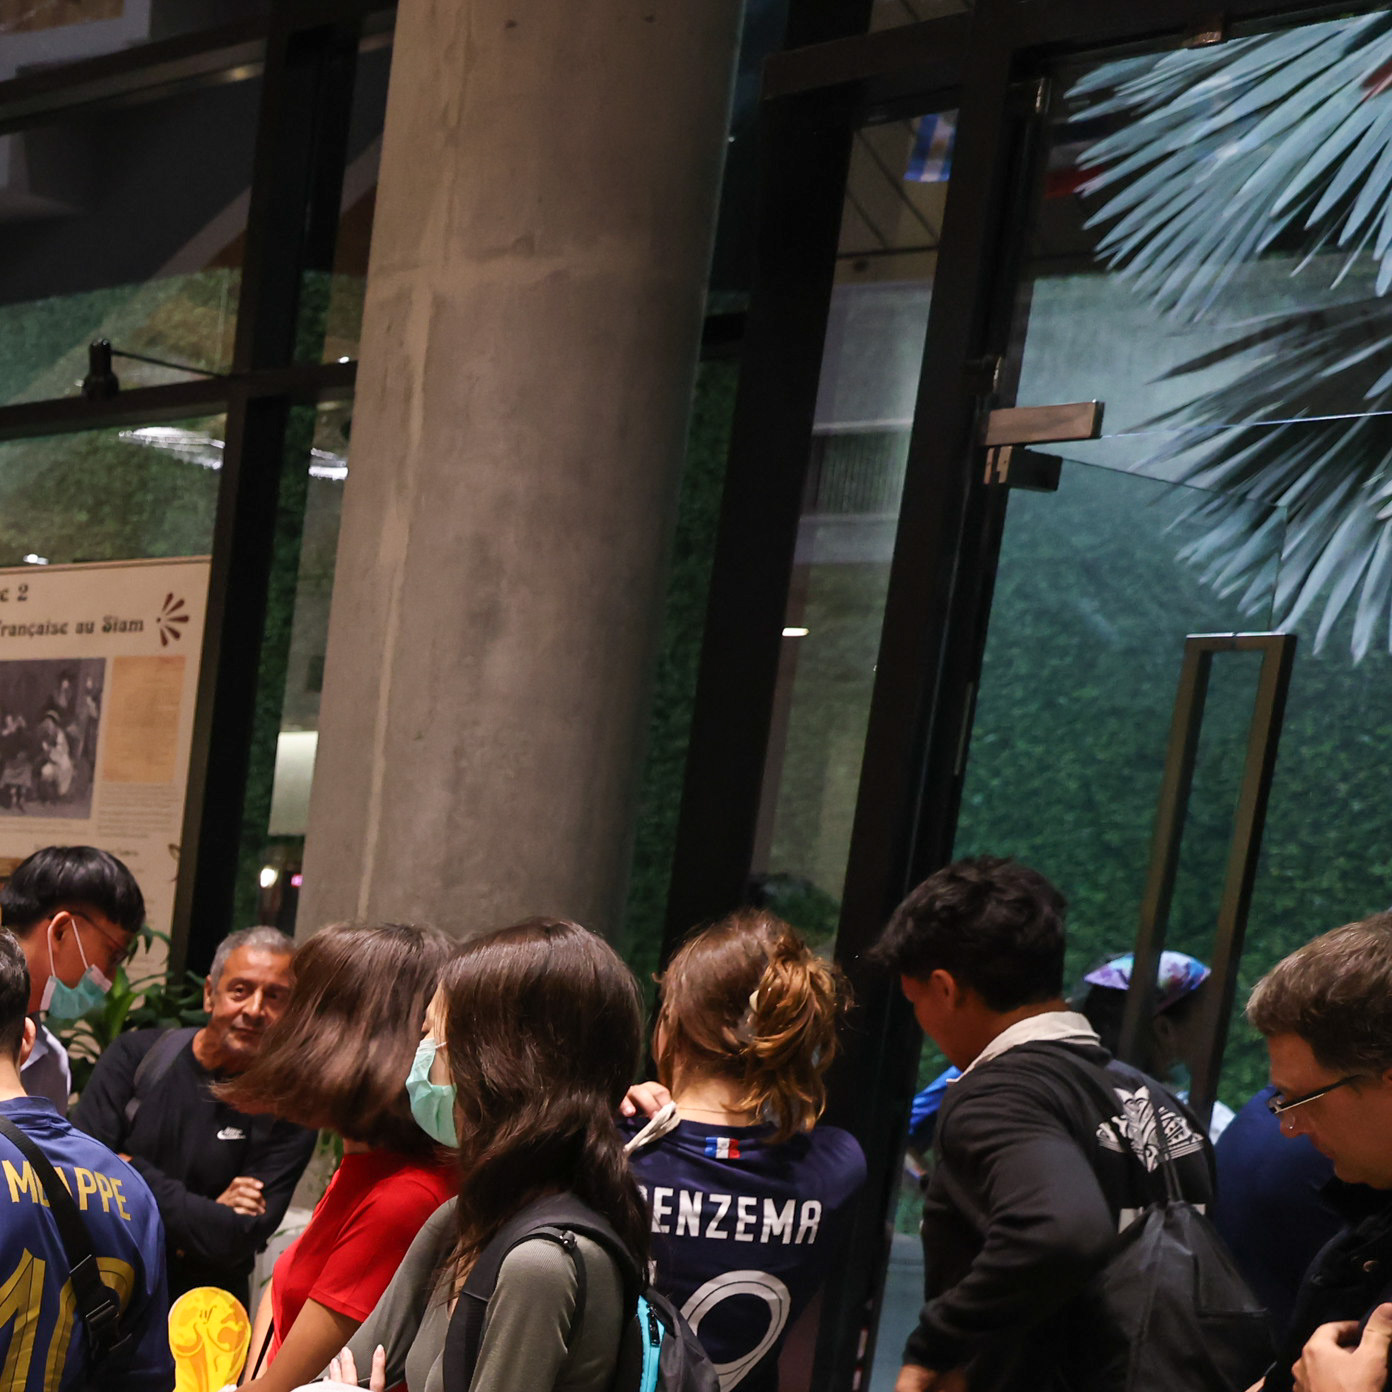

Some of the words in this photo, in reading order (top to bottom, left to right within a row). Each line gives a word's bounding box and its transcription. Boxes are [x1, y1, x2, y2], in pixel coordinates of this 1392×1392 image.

[17, 583, 29, 601] 2
[75, 620, 95, 634] au
[102, 615, 145, 633] Siam
[1, 1160, 131, 1221] MPPE
[638, 1185, 822, 1245] ENZEMA
